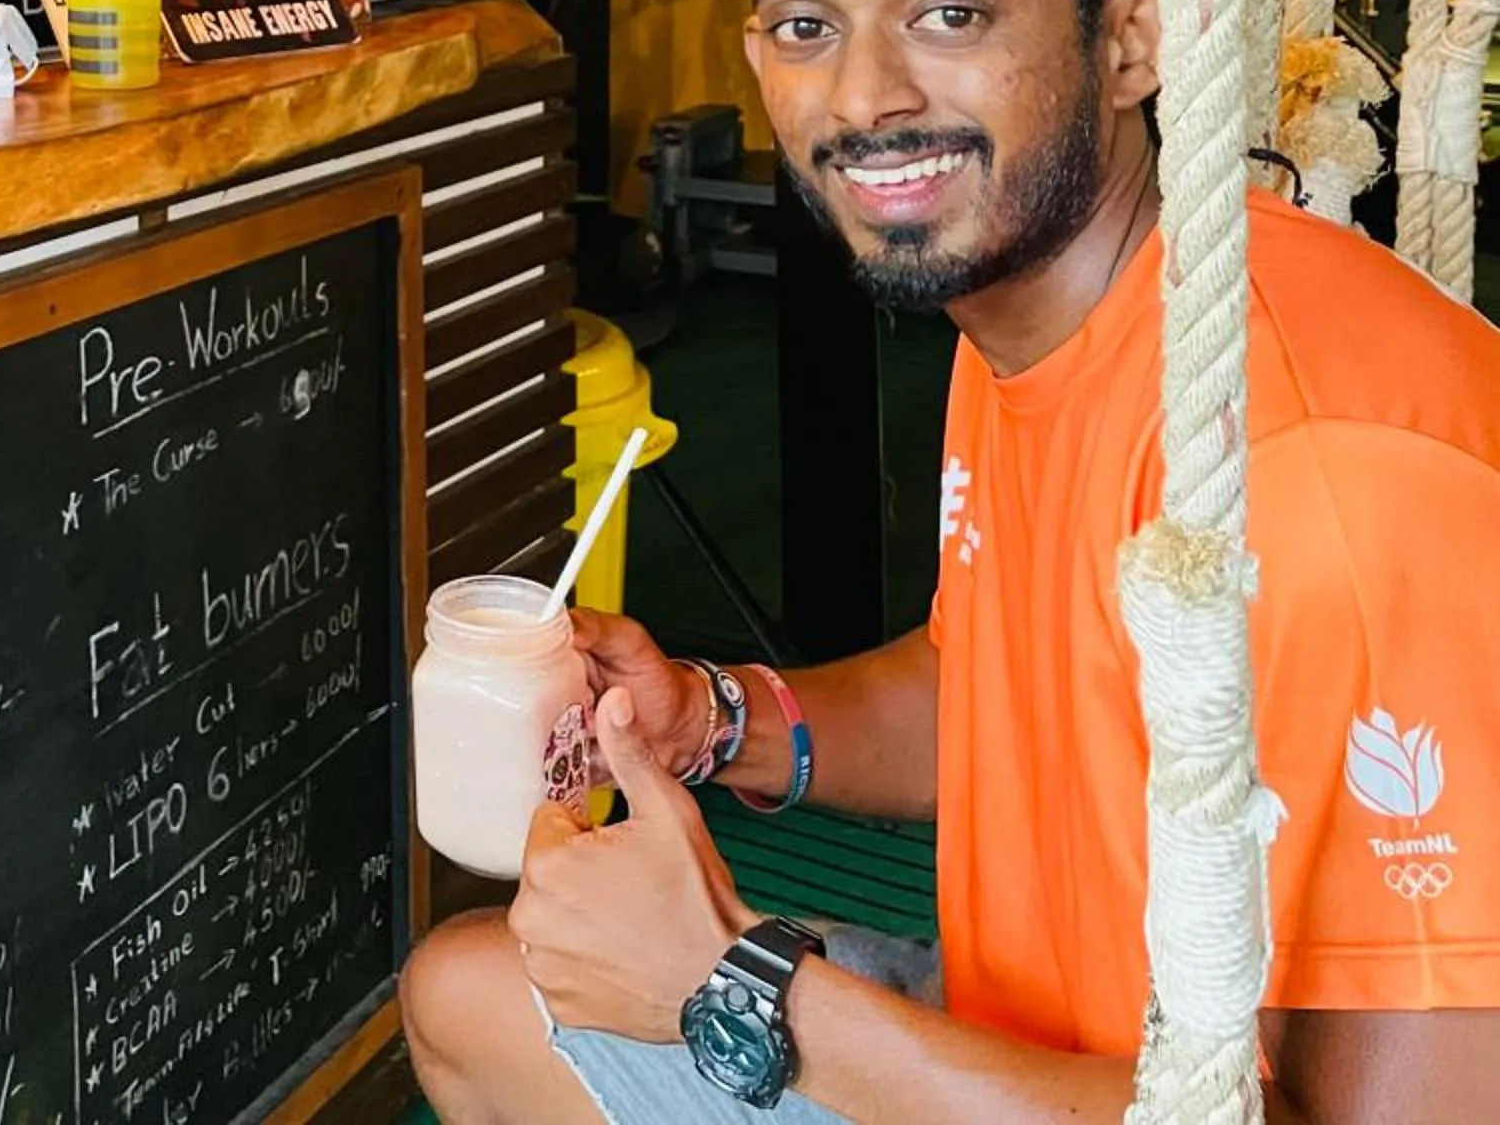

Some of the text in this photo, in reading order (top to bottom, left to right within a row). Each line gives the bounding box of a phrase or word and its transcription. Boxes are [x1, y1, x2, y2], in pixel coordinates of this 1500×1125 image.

[180, 6, 264, 45] INSANE
[152, 428, 219, 482] Curse
[109, 782, 187, 880] LIPO
[1367, 831, 1460, 859] TeamNL
[110, 915, 162, 981] Fish
[172, 862, 207, 916] Oil
[111, 988, 178, 1075] BCAA
